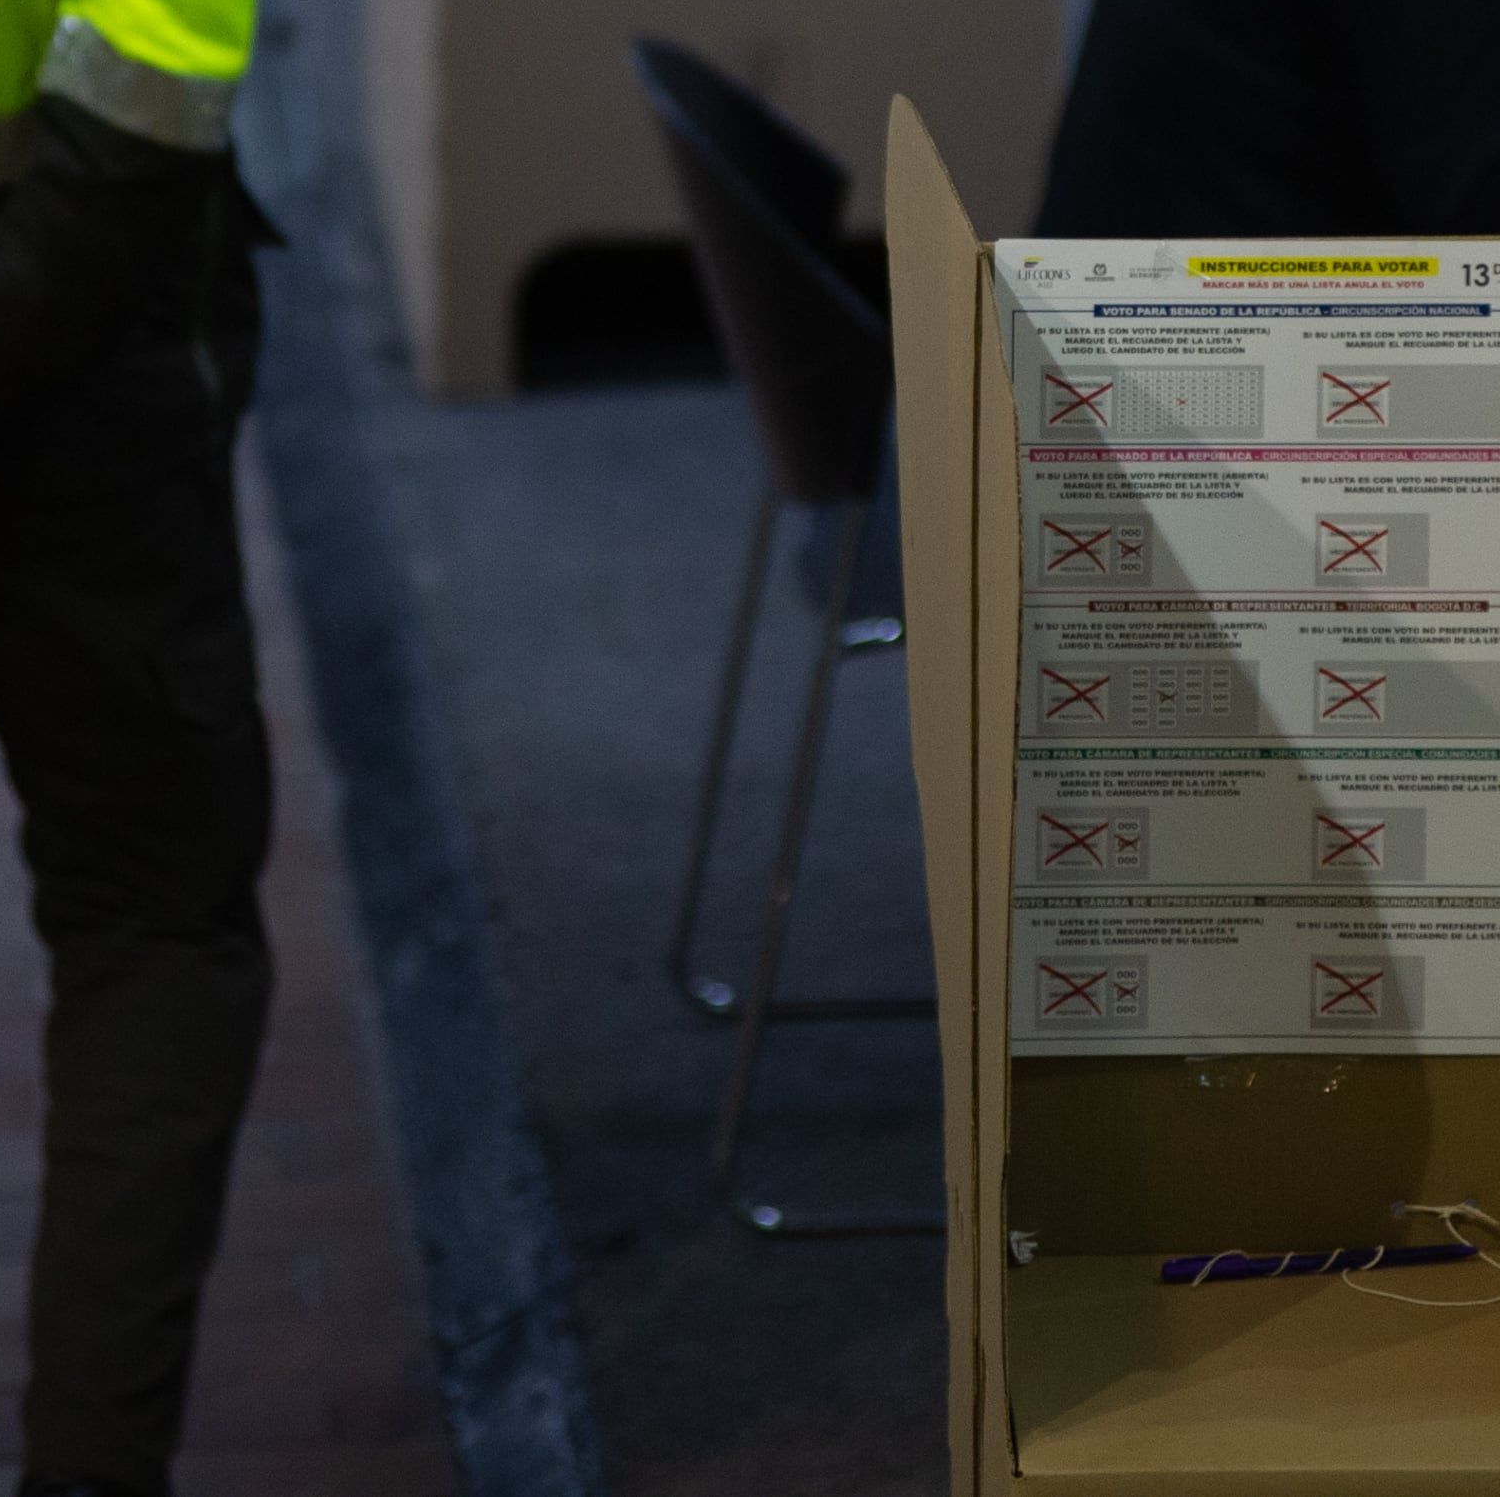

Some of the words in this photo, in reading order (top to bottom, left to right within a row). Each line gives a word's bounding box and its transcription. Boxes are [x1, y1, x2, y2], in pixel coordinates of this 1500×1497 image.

[1200, 261, 1328, 273] INSTRUCCIONES
[1333, 261, 1373, 273] PARA
[1378, 261, 1430, 273] VOTAR
[1462, 263, 1490, 287] 13
[1202, 281, 1245, 290] MARCAR
[1272, 281, 1285, 289] DE
[1288, 281, 1310, 289] UNA
[1312, 281, 1342, 289] LISTA
[1344, 281, 1377, 289] ANULA
[1381, 281, 1393, 289] EL
[1396, 281, 1425, 289] VOTO
[1102, 306, 1133, 316] VOTO
[1136, 306, 1167, 316] PARA
[1170, 306, 1217, 316] SENADO
[1220, 306, 1235, 316] DE
[1238, 306, 1253, 316] LA
[1428, 306, 1485, 316] NACIONAL
[1036, 327, 1046, 335] SI
[1048, 327, 1062, 335] SU
[1064, 327, 1091, 335] LISTA
[1094, 327, 1106, 335] ES
[1108, 327, 1129, 335] CON
[1132, 327, 1157, 335] VOTO
[1159, 327, 1220, 335] PREFERENTE
[1224, 327, 1272, 335] (ABIERTA)
[1302, 331, 1312, 339] SI
[1315, 331, 1328, 339] SU
[1330, 331, 1357, 339] LISTA
[1360, 331, 1372, 339] ES
[1374, 331, 1395, 339] CON
[1398, 331, 1423, 339] VOTO
[1425, 331, 1439, 339] NO
[1064, 337, 1105, 345] MARQUE
[1108, 337, 1119, 345] EL
[1122, 337, 1174, 345] RECUADRO
[1176, 337, 1188, 345] DE
[1191, 337, 1203, 345] LA
[1206, 337, 1233, 345] LISTA
[1236, 337, 1243, 345] Y
[1345, 341, 1385, 349] MARQUE
[1388, 341, 1400, 349] EL
[1403, 341, 1455, 349] RECUADRO
[1457, 341, 1469, 349] DE
[1472, 341, 1484, 349] LA
[1061, 347, 1093, 355] LUEGO
[1096, 347, 1107, 355] EL
[1110, 347, 1164, 355] CANDIDATO
[1167, 347, 1179, 355] DE
[1182, 347, 1195, 355] SU
